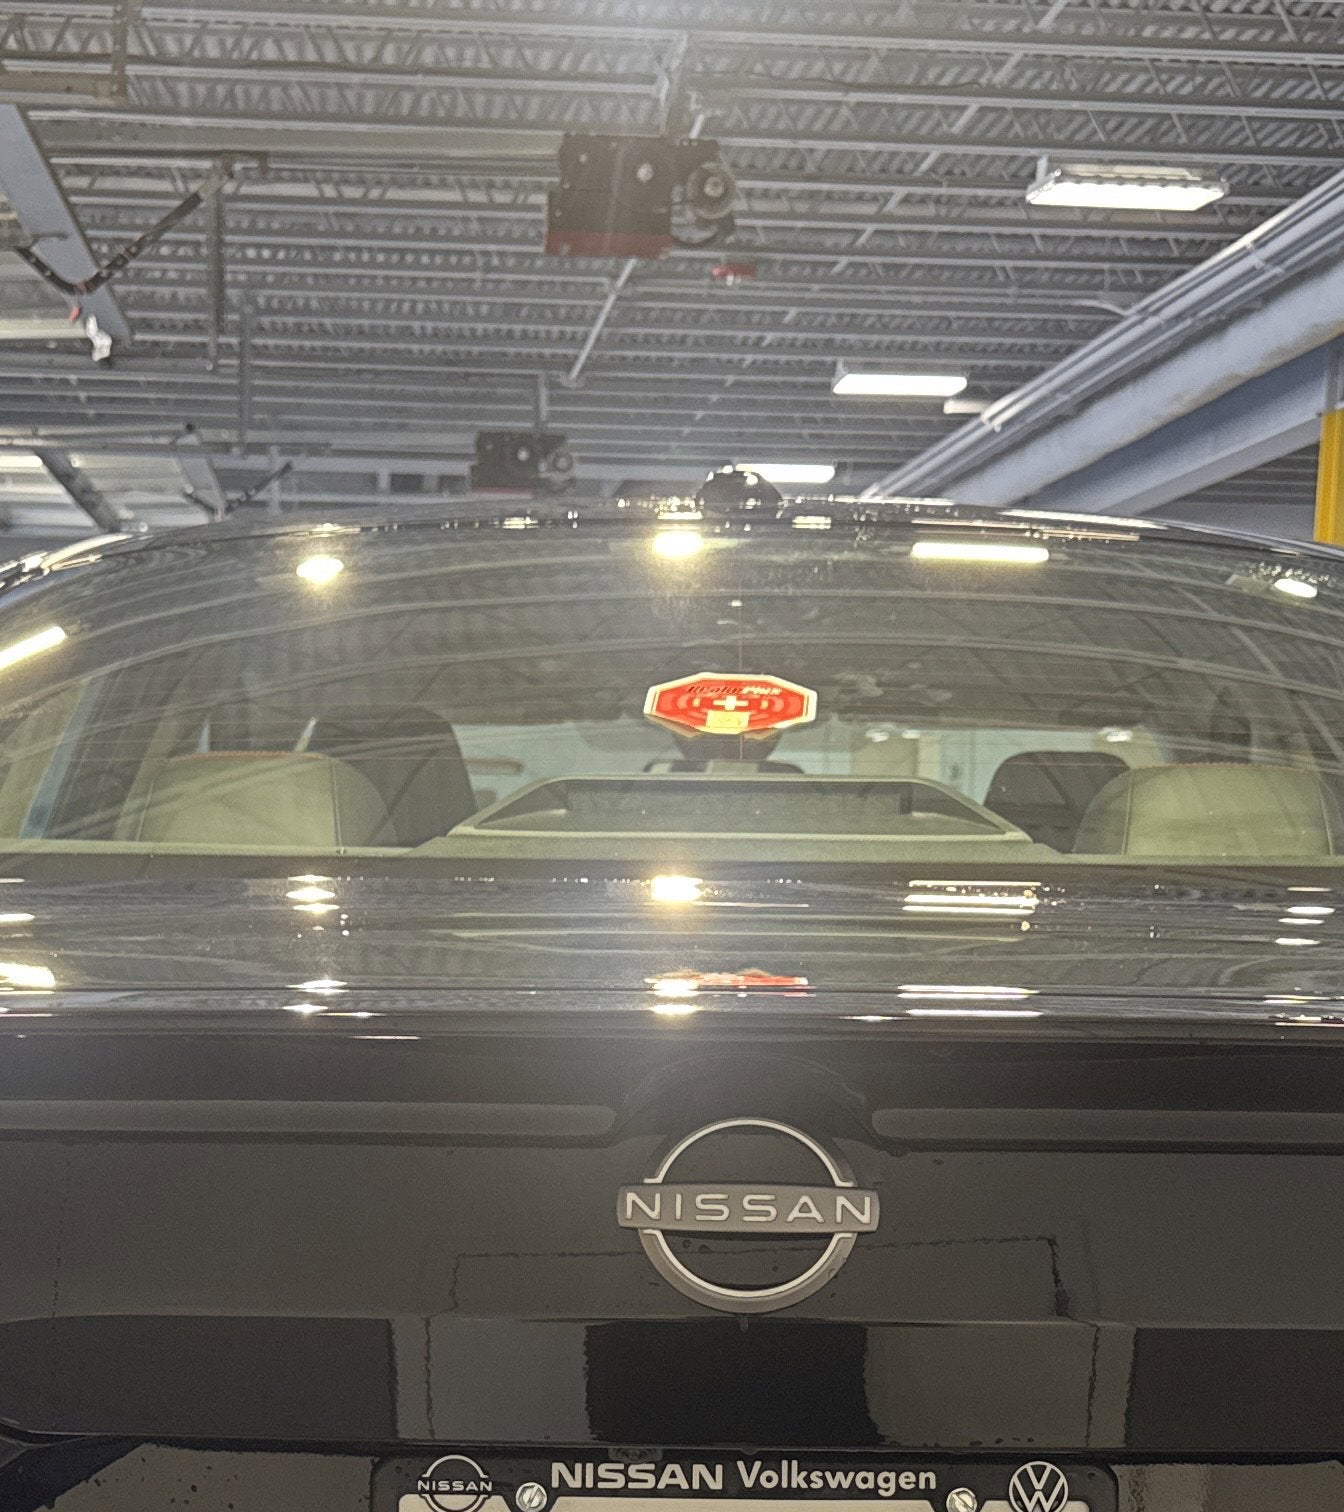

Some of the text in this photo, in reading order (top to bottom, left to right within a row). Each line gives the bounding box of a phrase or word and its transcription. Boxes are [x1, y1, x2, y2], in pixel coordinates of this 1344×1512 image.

[624, 1191, 872, 1225] NISSAN
[417, 1479, 493, 1492] NISSAN
[551, 1459, 937, 1497] NISSAN Volkswagen
